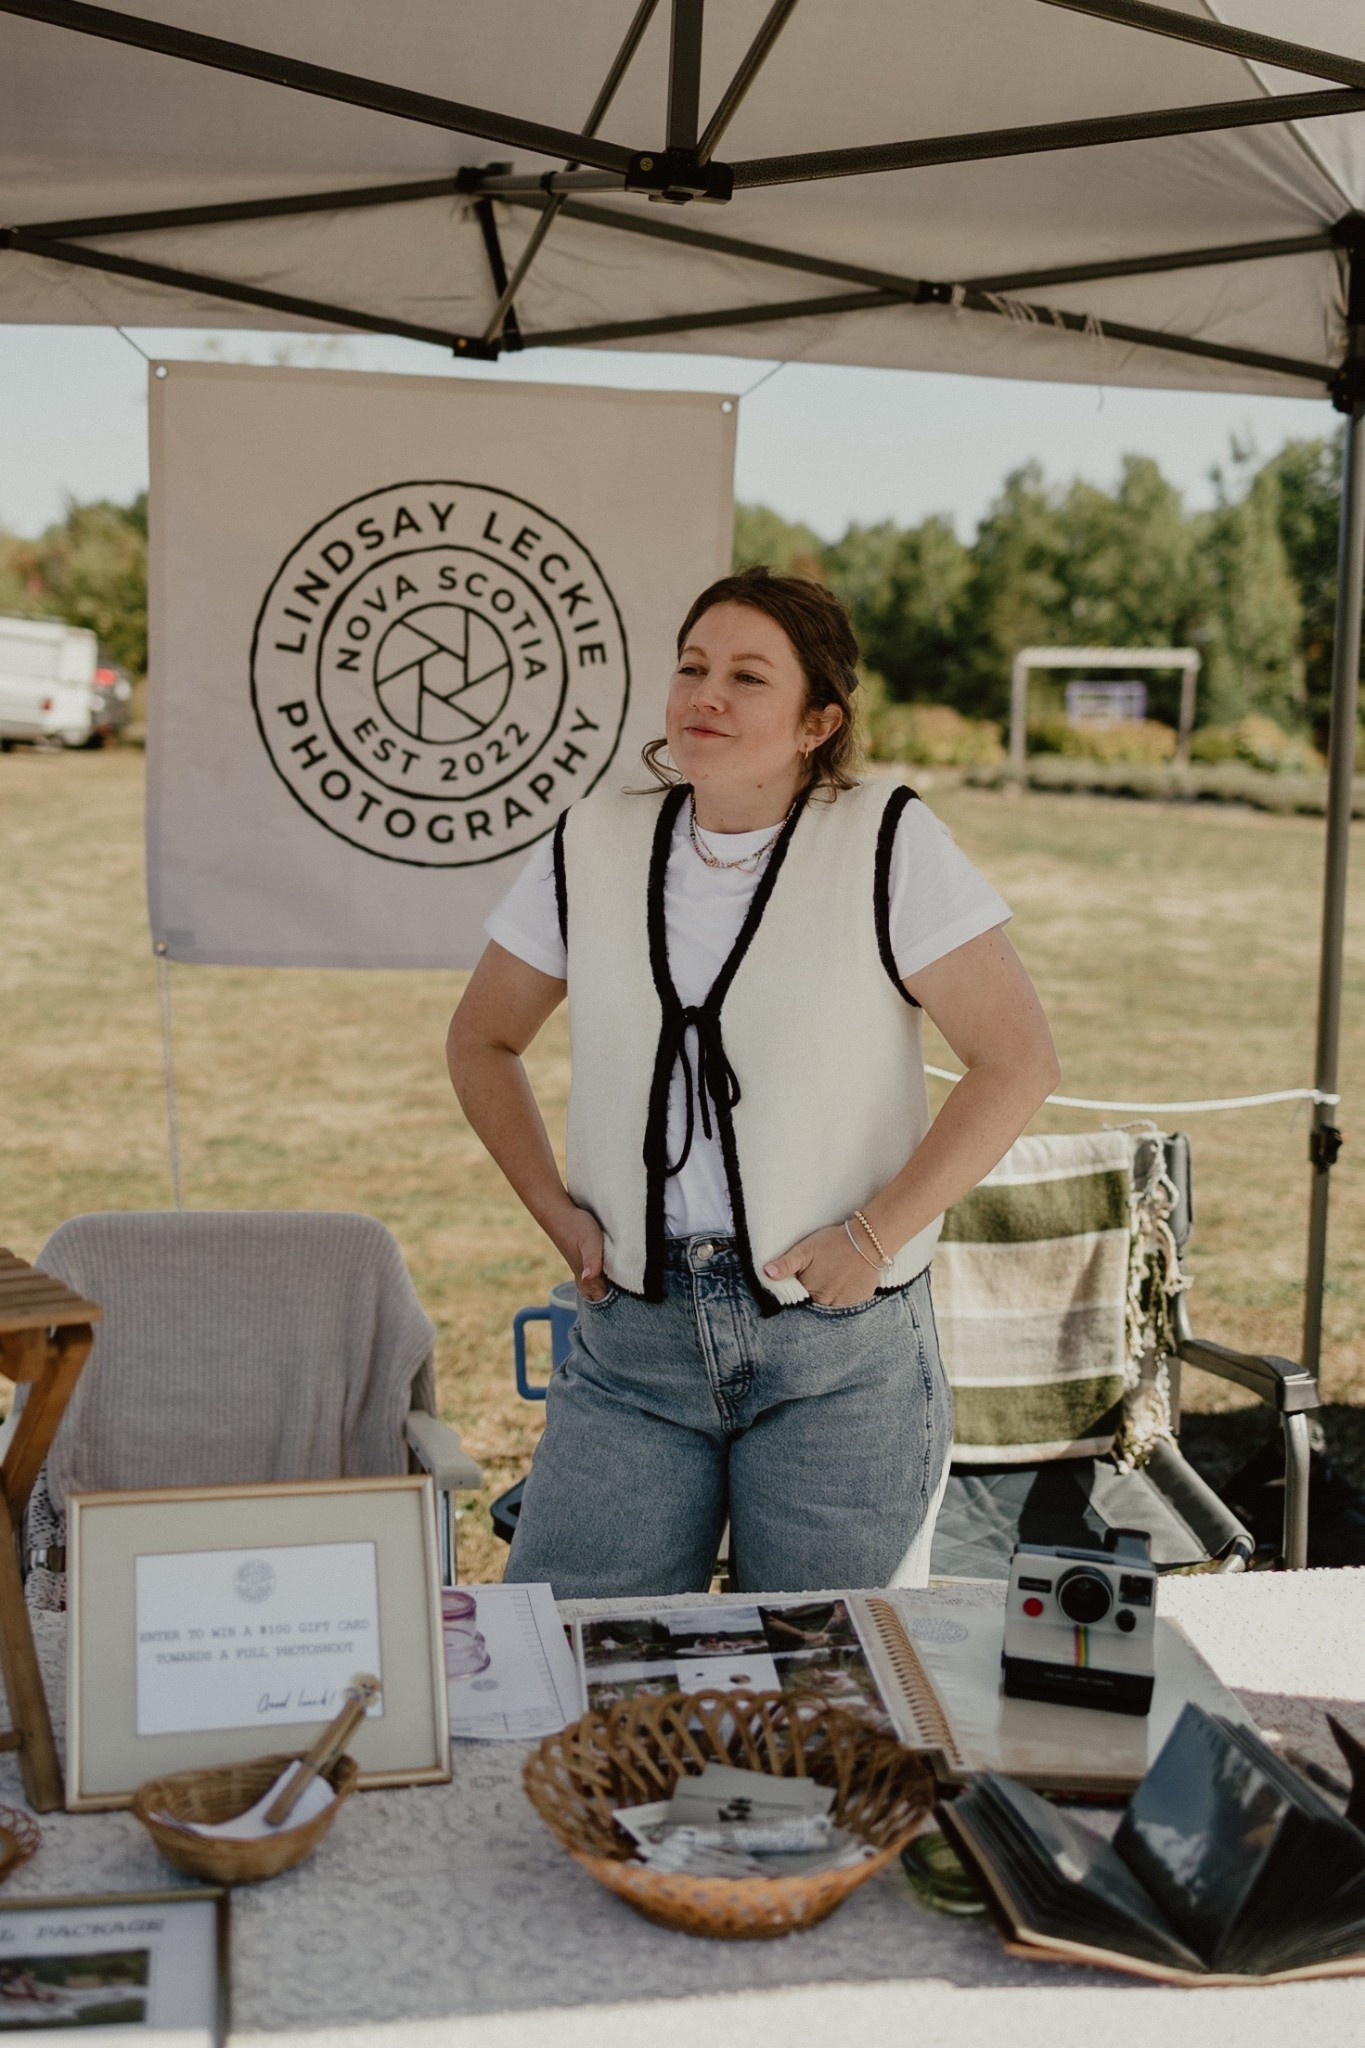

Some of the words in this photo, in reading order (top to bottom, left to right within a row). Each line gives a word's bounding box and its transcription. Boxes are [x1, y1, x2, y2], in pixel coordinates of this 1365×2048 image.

[275, 502, 455, 655] LINDSAY
[482, 511, 607, 668] LECKIE
[336, 574, 420, 673] NOVA
[438, 565, 548, 681] SCOTIA
[277, 700, 600, 844] PHOTOGRAPHY
[353, 717, 421, 775] EST
[439, 722, 530, 782] 2022
[139, 1629, 179, 1642] ENTER
[188, 1628, 204, 1640] TO
[211, 1626, 236, 1639] WIN
[243, 1625, 252, 1637] A
[298, 1620, 330, 1633] GIFT
[337, 1618, 370, 1631] CARD
[155, 1650, 212, 1663] TOWARDS
[220, 1648, 229, 1660] A
[235, 1646, 268, 1659] FULL
[35, 1918, 165, 1940] PACKAGE
